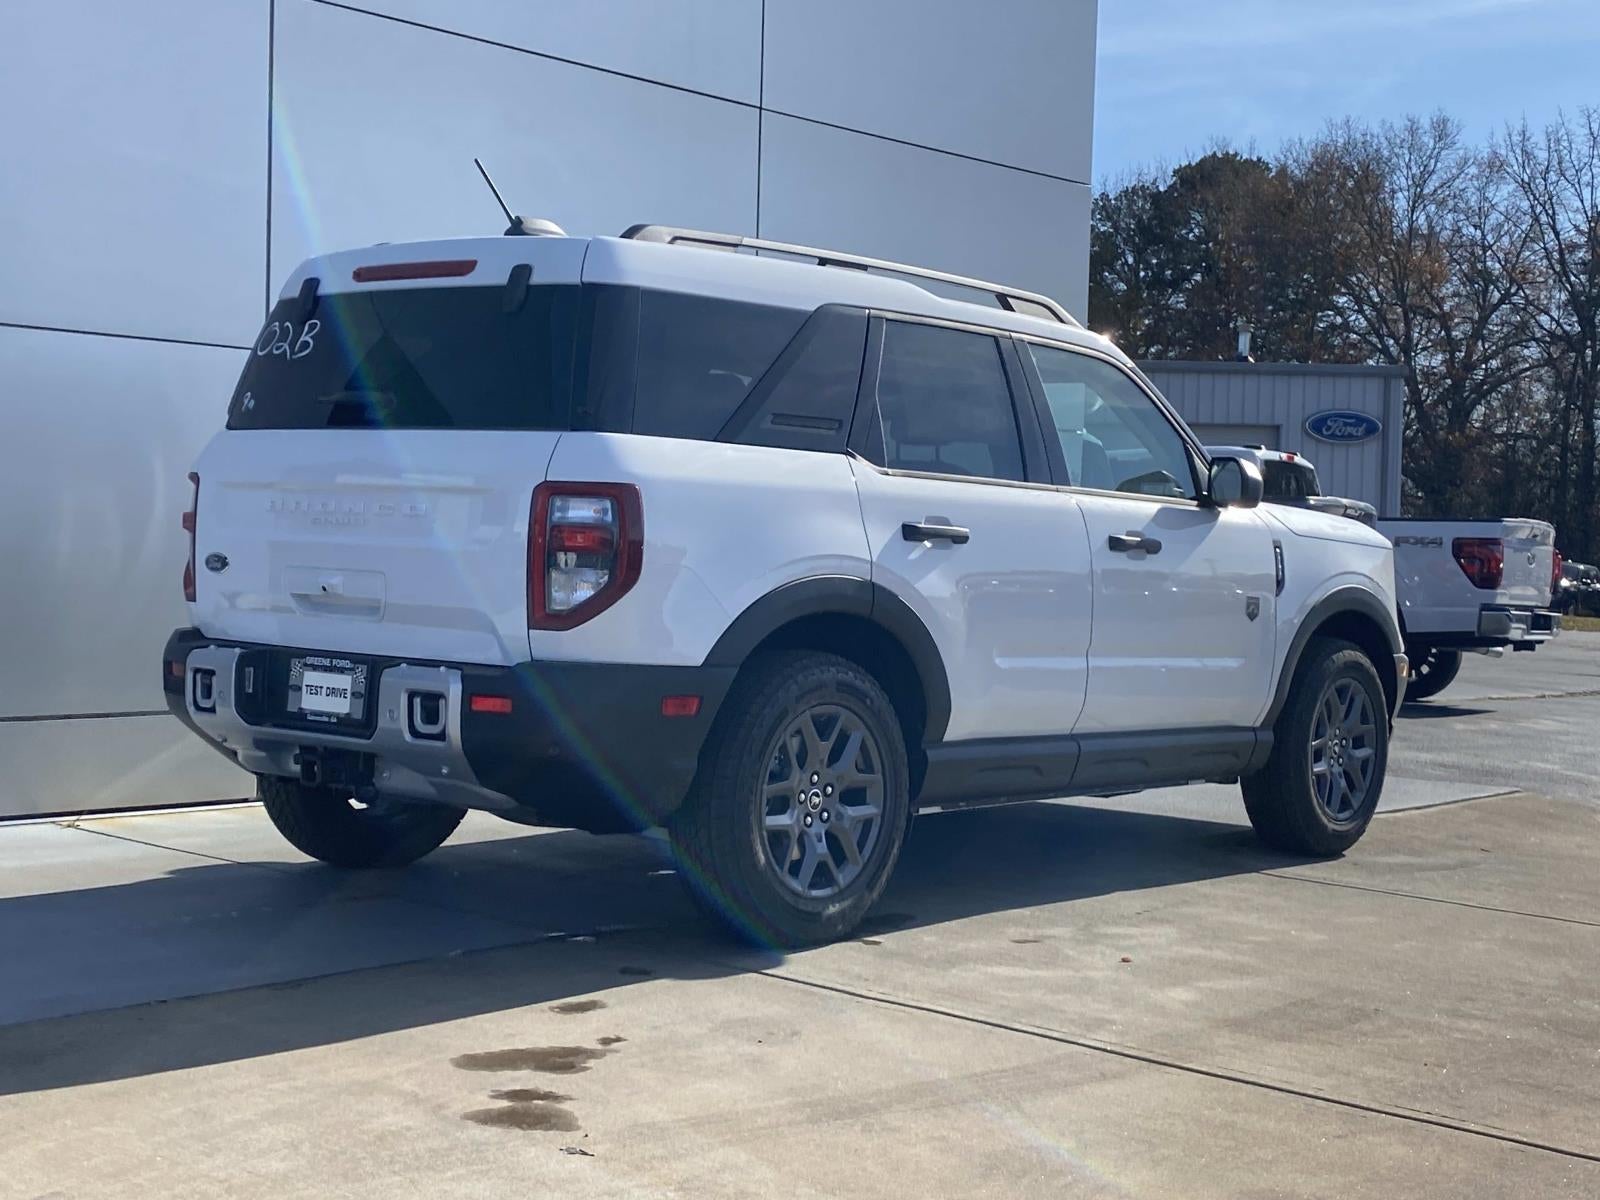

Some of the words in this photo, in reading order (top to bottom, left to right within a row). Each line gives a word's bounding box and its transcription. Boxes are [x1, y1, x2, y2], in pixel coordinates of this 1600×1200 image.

[1322, 417, 1367, 436] Ford
[332, 659, 351, 668] FORD
[304, 684, 324, 696] TEST
[325, 686, 349, 699] DRIVE
